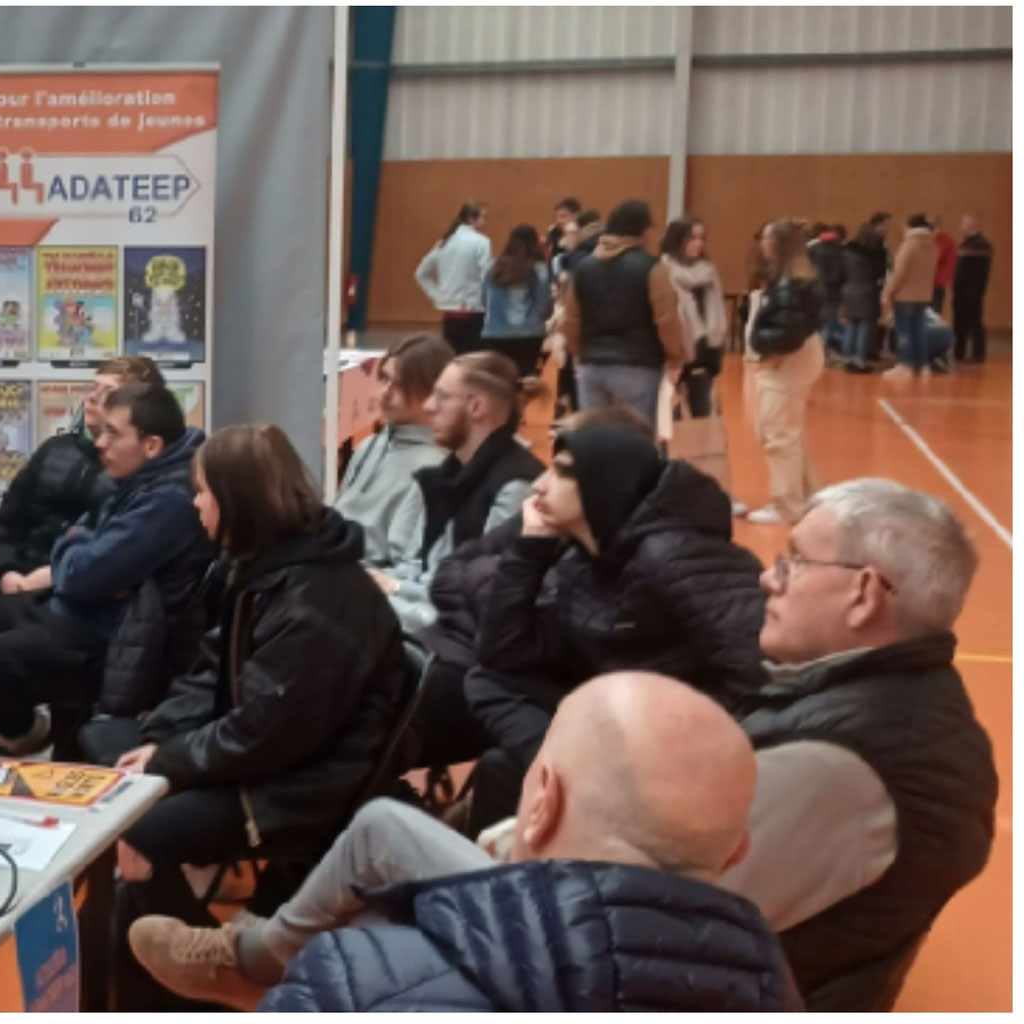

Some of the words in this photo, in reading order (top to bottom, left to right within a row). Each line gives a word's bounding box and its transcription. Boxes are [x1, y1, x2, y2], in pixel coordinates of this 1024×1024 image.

[34, 90, 176, 107] l'amélioration
[107, 114, 131, 128] de
[138, 113, 206, 132] jeunes
[47, 174, 191, 201] ADATEEP
[128, 207, 158, 223] 62
